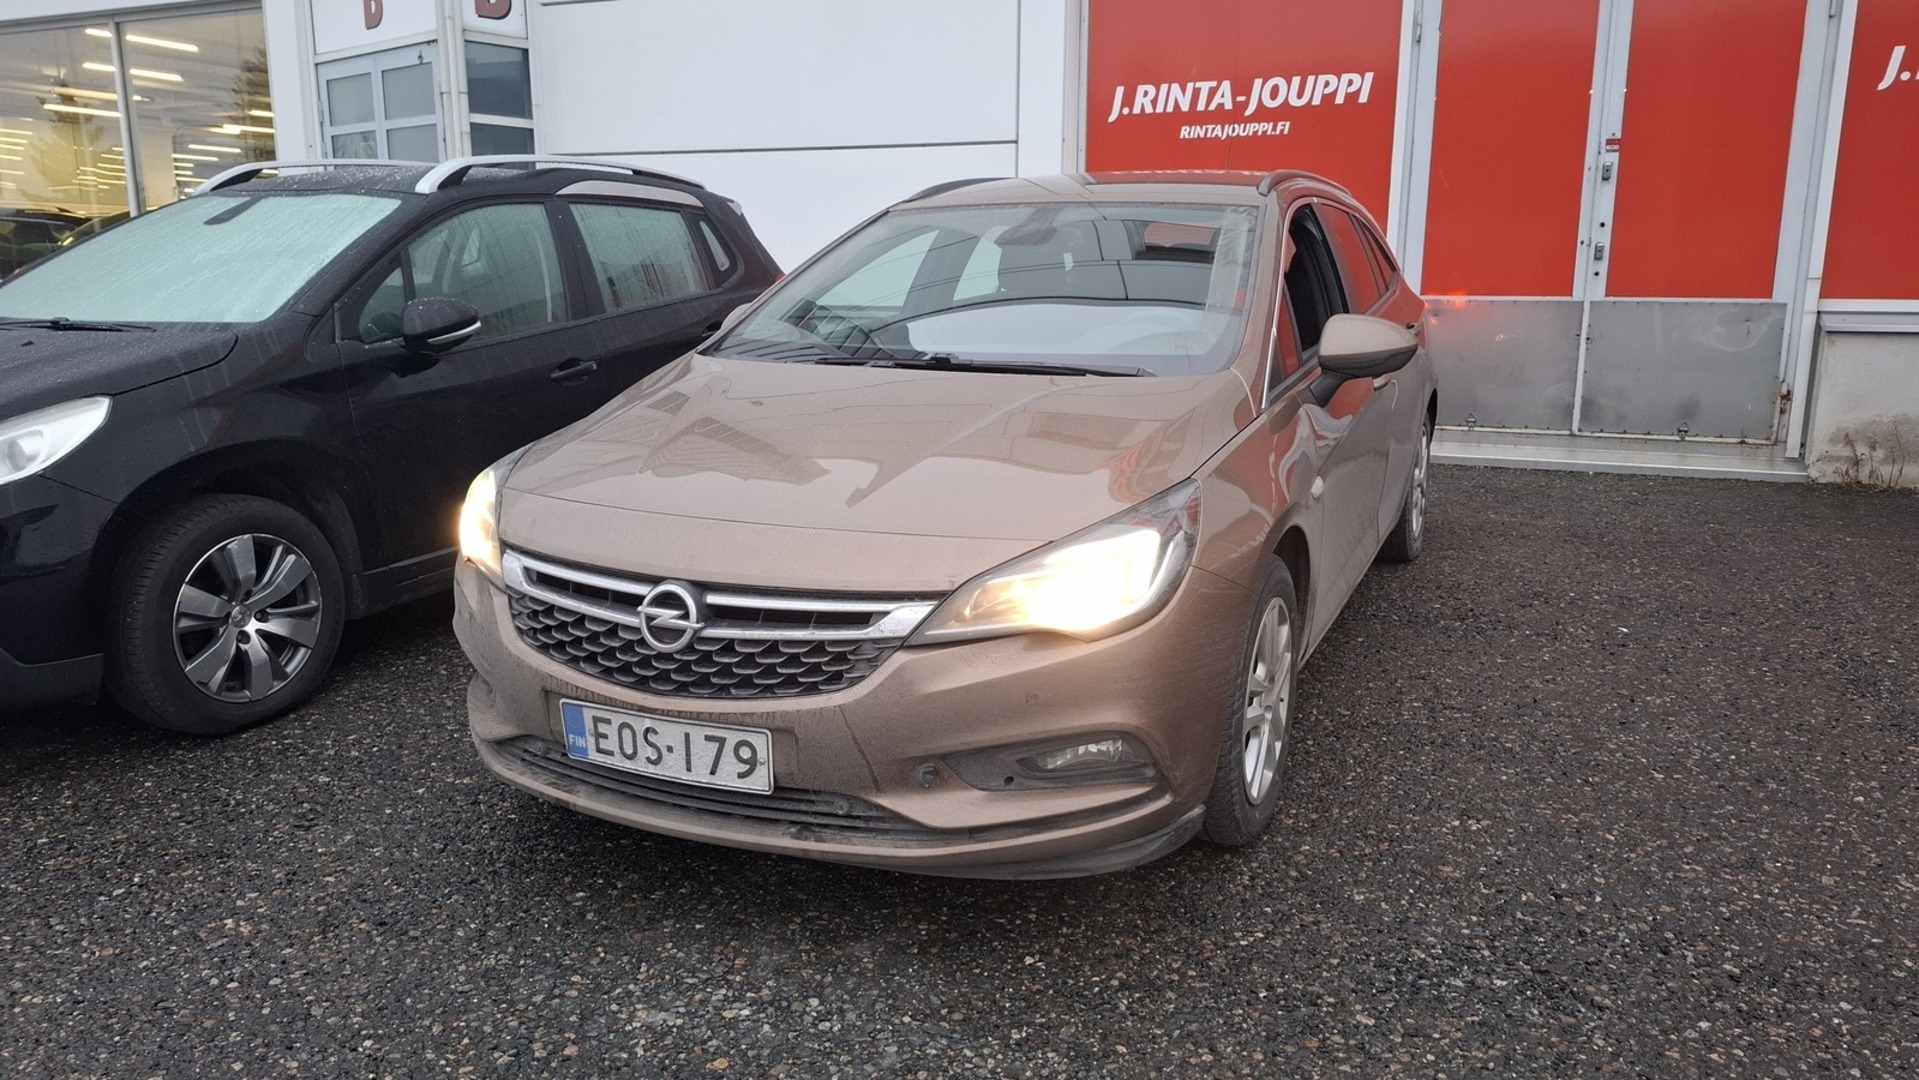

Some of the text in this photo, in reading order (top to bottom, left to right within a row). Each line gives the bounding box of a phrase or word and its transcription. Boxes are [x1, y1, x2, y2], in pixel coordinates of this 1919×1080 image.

[1877, 45, 1919, 91] J.
[1107, 71, 1375, 123] J.RINTA-JOUPPI
[1179, 121, 1291, 141] RINTAJOUPPI.FI
[568, 733, 587, 748] FIN
[591, 715, 758, 780] EOS-179
